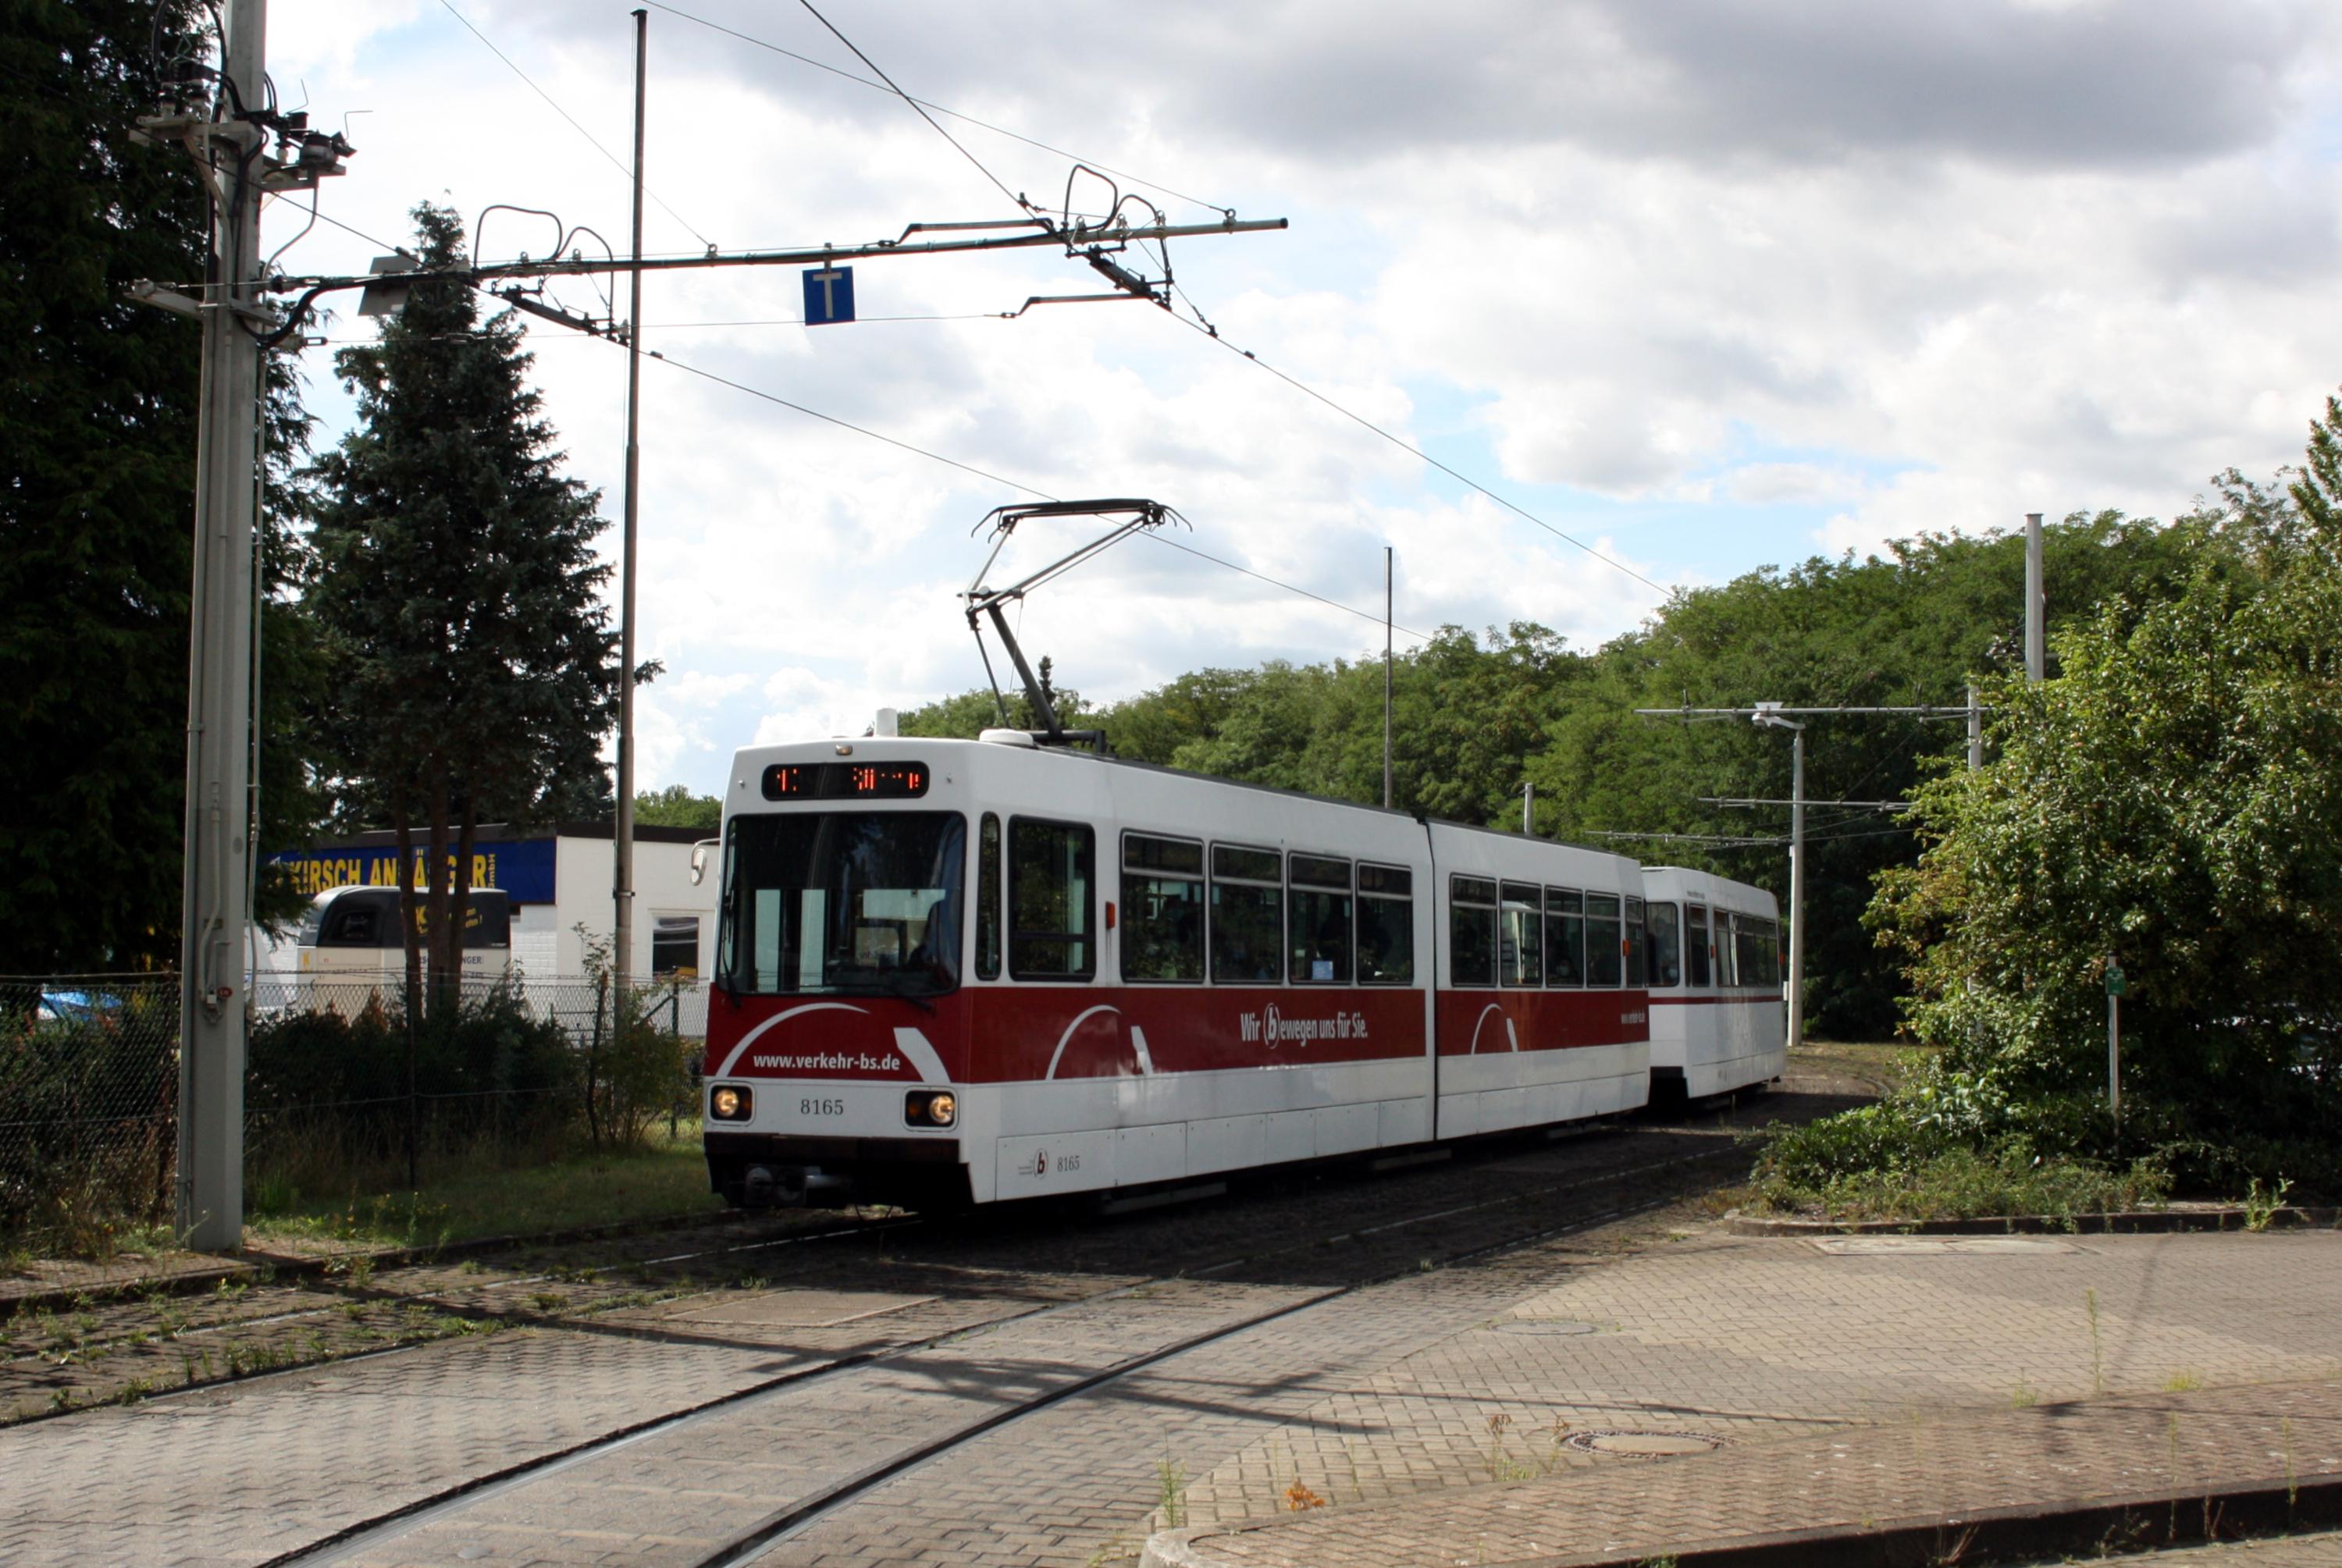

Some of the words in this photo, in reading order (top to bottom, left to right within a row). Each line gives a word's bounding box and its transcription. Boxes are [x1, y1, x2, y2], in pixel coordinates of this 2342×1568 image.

[813, 272, 843, 319] T
[1240, 1012, 1261, 1042] Wir
[1319, 1019, 1336, 1040] uns
[1337, 1011, 1351, 1039] für
[1352, 1011, 1368, 1039] Sie.
[753, 1052, 900, 1071] www.verkehr-bs.de
[800, 1099, 844, 1116] 8165
[1057, 1155, 1080, 1172] 8165
